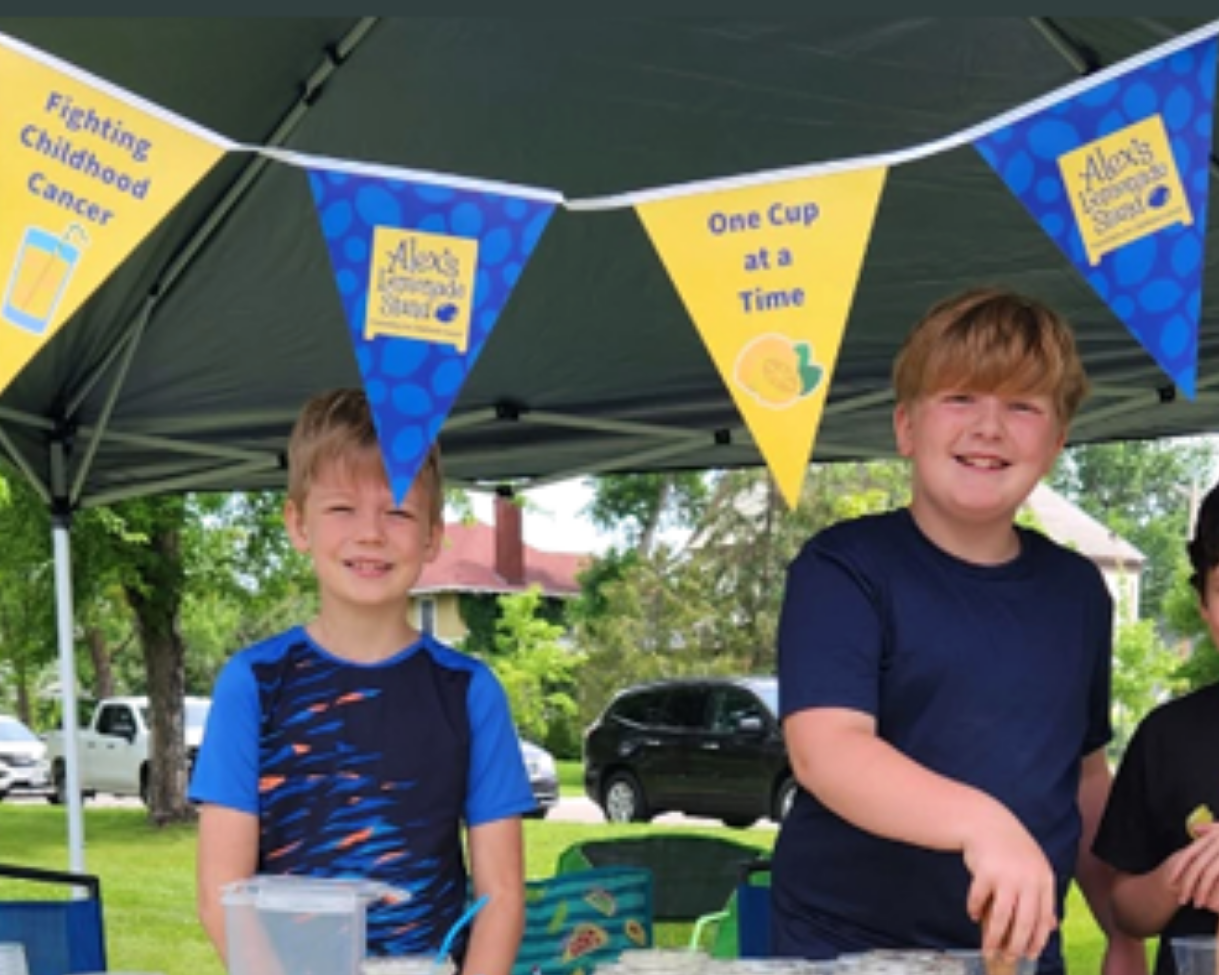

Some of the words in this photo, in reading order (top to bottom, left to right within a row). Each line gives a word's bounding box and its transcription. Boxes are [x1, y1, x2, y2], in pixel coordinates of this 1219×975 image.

[45, 90, 152, 162] Fighting
[20, 124, 151, 199] Childhood
[27, 172, 115, 226] Cancer
[708, 211, 760, 235] One
[768, 202, 820, 228] Cup
[744, 247, 770, 271] at
[777, 247, 793, 266] a
[738, 287, 805, 314] Time
